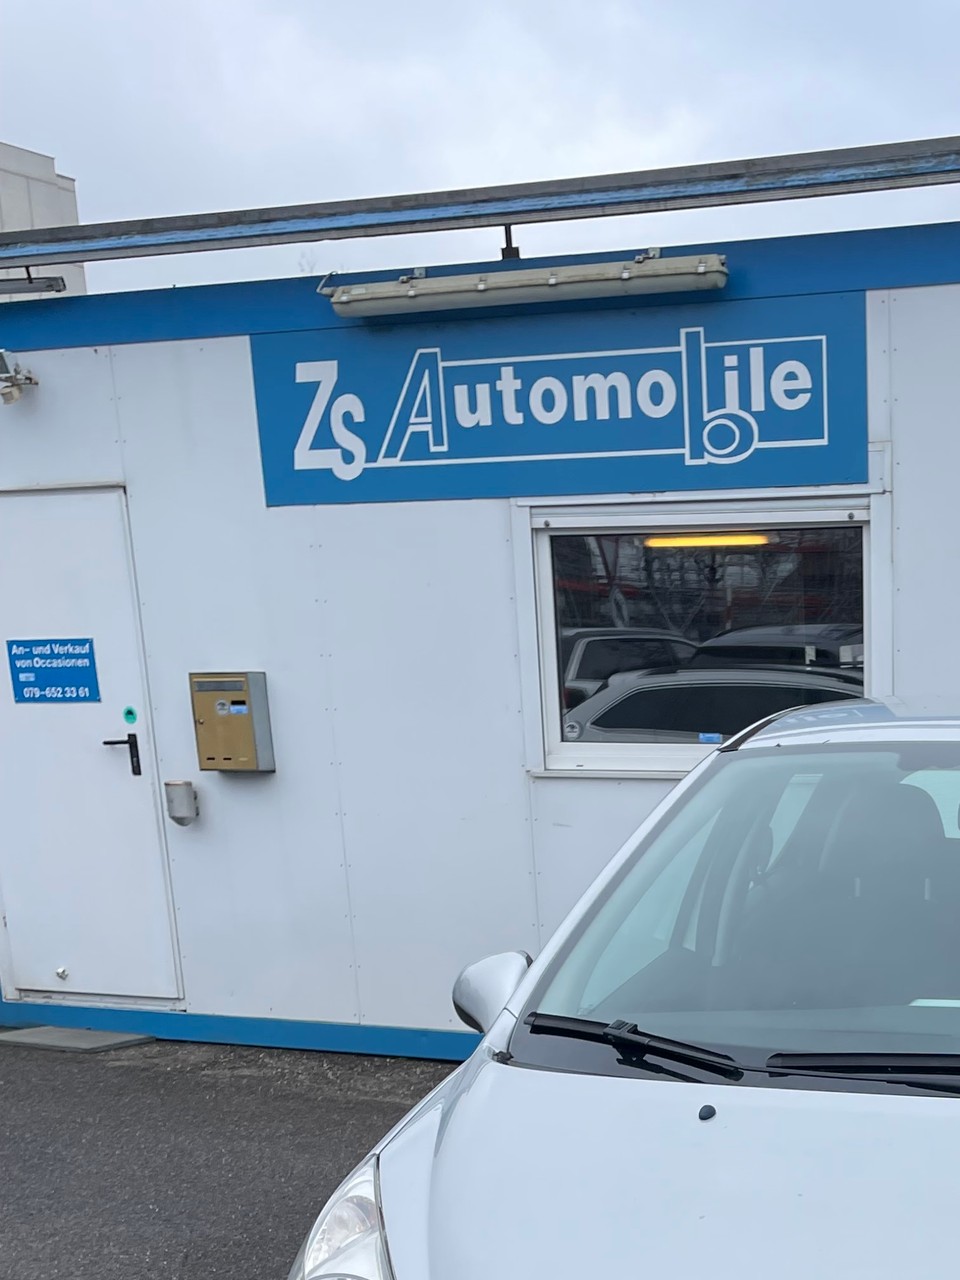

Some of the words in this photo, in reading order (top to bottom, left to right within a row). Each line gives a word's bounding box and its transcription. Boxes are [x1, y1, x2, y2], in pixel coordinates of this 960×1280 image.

[374, 327, 814, 465] Automobile
[32, 643, 51, 655] und
[52, 642, 91, 654] Verkauf
[15, 659, 33, 668] von
[33, 656, 90, 668] Occasionen
[23, 686, 63, 698] 079-652
[64, 686, 77, 698] 33
[78, 686, 90, 698] 61
